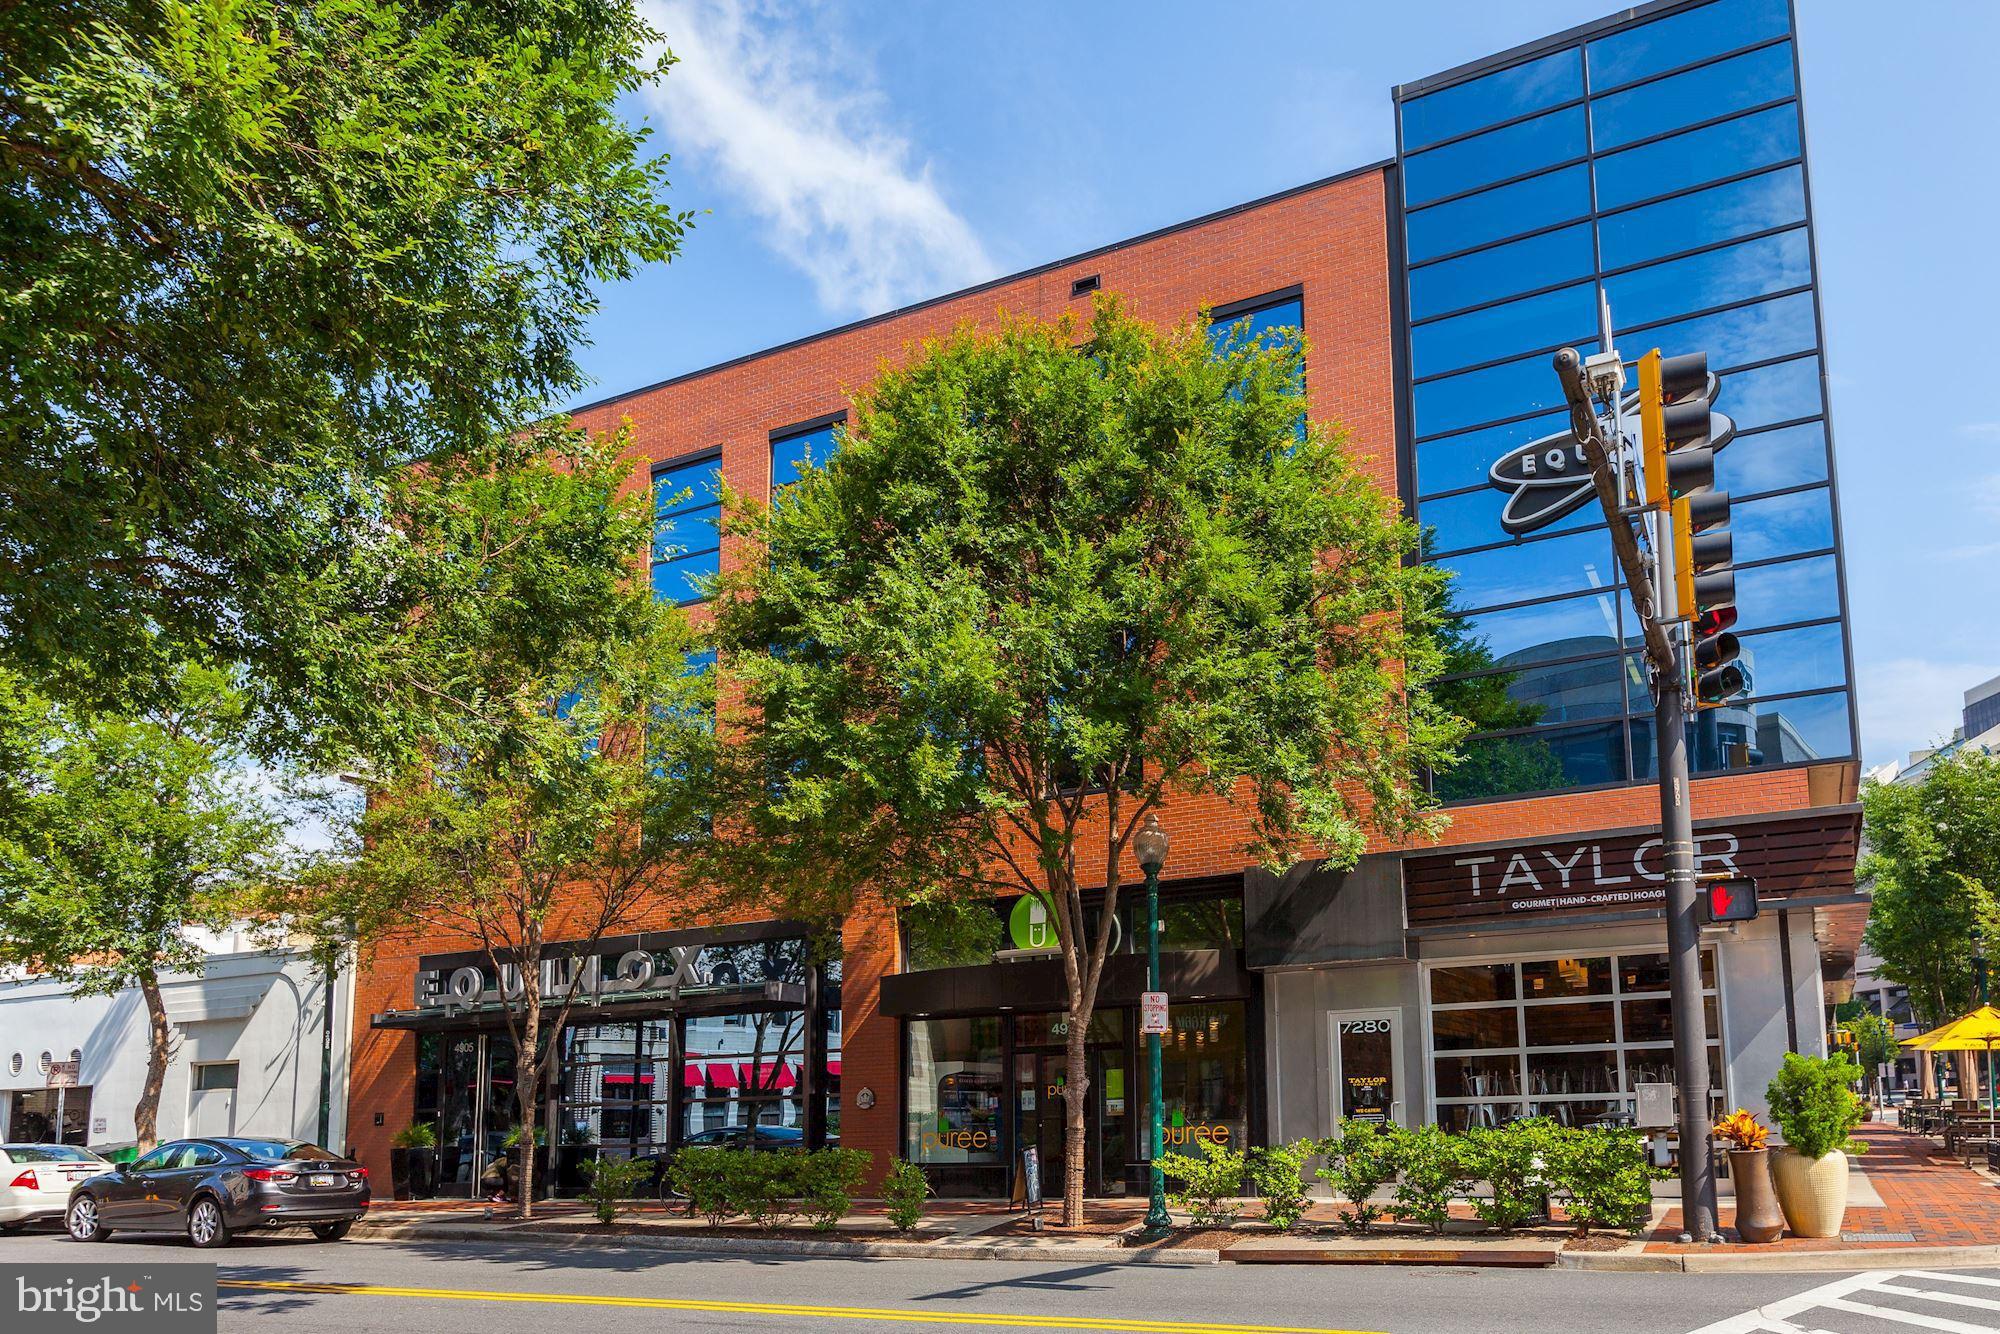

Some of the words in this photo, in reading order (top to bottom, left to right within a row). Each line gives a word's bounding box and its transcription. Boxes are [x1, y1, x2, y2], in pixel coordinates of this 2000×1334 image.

[1634, 889, 1666, 900] HOAGI
[414, 944, 706, 1010] EQUINOX
[1150, 995, 1160, 1004] NO
[1143, 1004, 1167, 1012] STOPPING
[1051, 1022, 1068, 1035] 49
[1340, 1020, 1391, 1034] 7280
[1347, 1076, 1387, 1084] TAYLOR
[922, 1127, 988, 1153] purée
